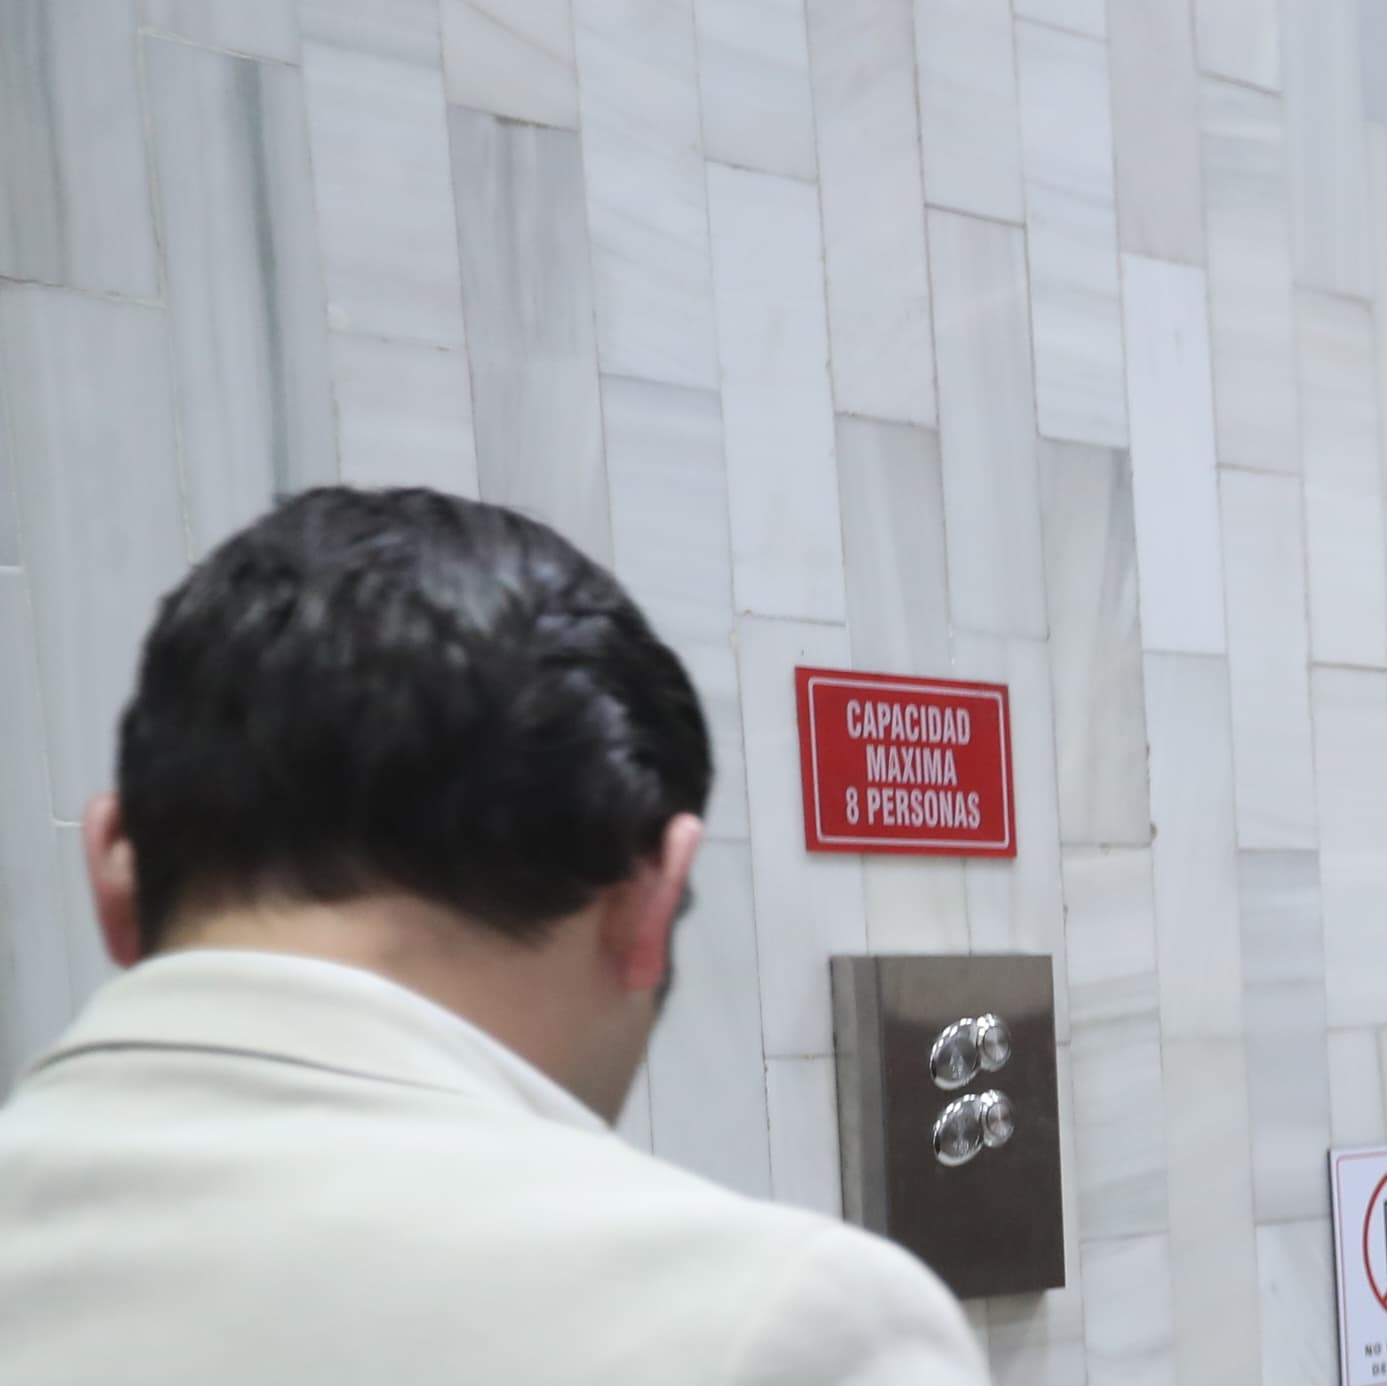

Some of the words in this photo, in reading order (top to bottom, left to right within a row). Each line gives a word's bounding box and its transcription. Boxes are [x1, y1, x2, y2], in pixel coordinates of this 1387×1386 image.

[846, 699, 972, 745] CAPACIDAD
[865, 744, 958, 786] MAXIMA
[845, 786, 860, 826] 8
[867, 787, 981, 829] PERSONAS
[1364, 1343, 1382, 1357] NO
[1371, 1361, 1387, 1376] DE
